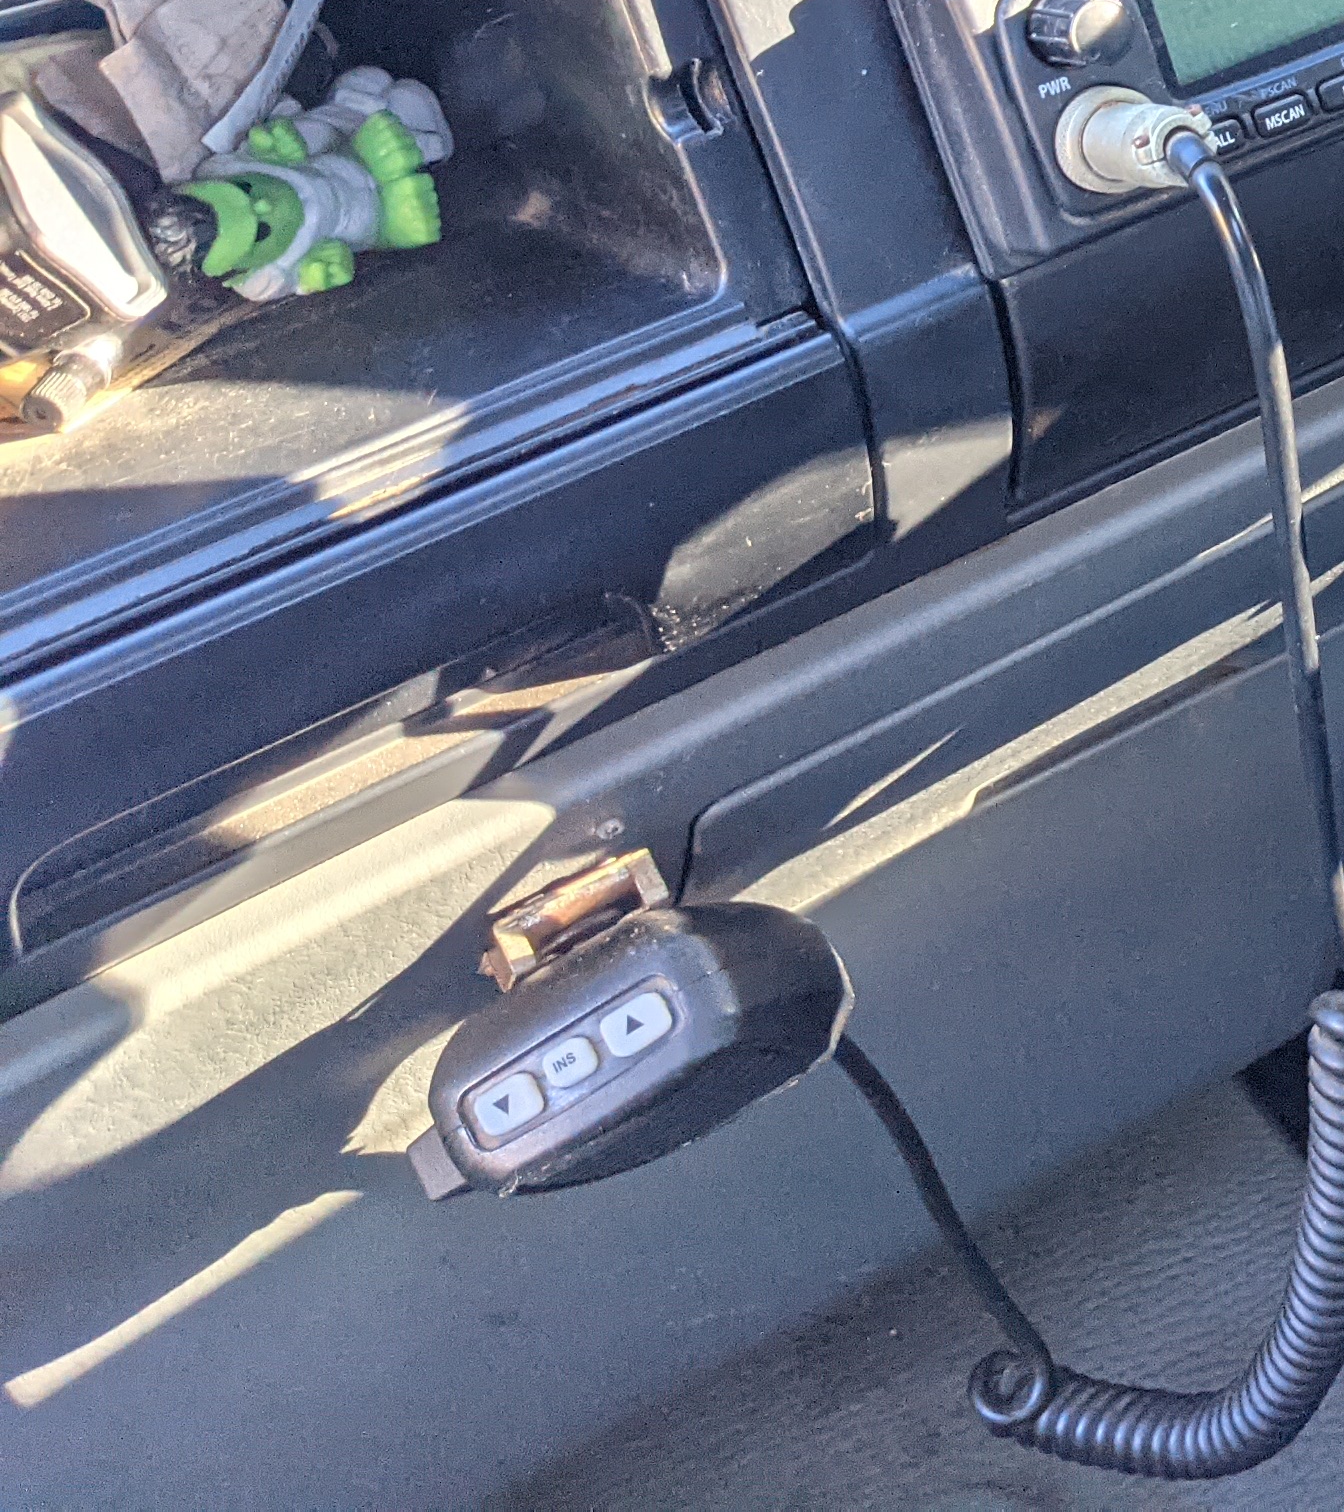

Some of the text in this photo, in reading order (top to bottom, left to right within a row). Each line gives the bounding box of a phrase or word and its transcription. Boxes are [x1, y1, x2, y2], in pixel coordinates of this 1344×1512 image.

[1037, 76, 1072, 100] PWR
[1264, 103, 1306, 131] MSCAN
[551, 1050, 577, 1075] INS
